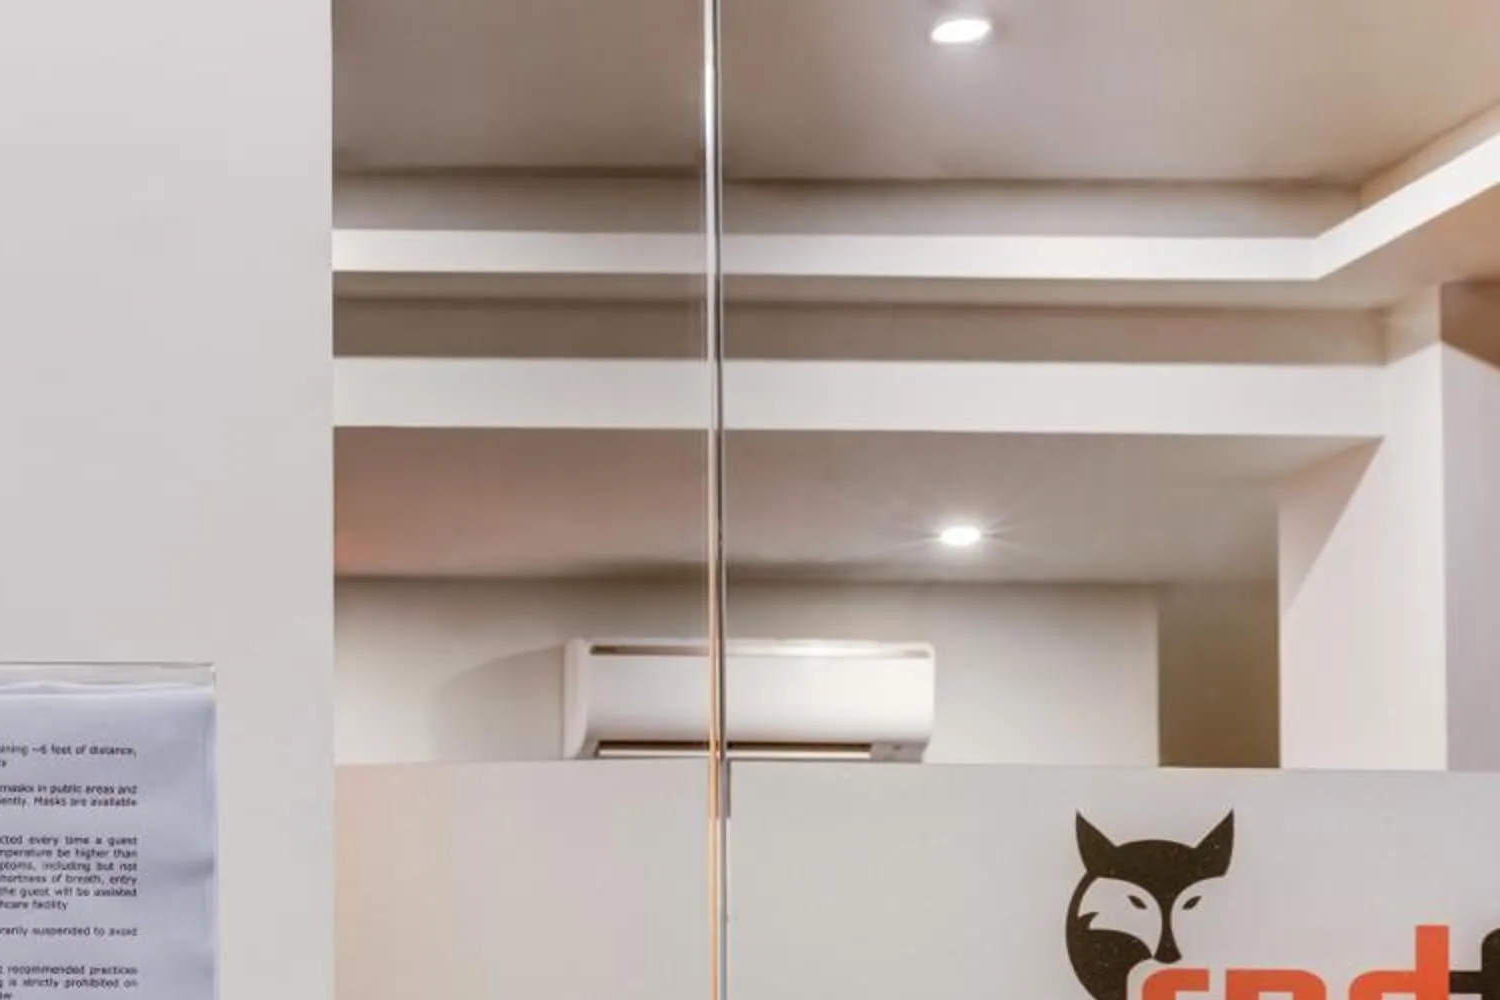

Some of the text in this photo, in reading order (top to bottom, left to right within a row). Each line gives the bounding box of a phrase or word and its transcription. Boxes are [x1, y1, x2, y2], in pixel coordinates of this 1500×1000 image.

[49, 744, 72, 755] feet
[74, 744, 87, 755] of
[116, 783, 138, 794] and
[55, 847, 70, 858] be
[112, 847, 138, 858] than
[95, 860, 114, 871] but
[50, 872, 62, 883] of
[75, 885, 90, 896] be
[92, 925, 105, 936] to
